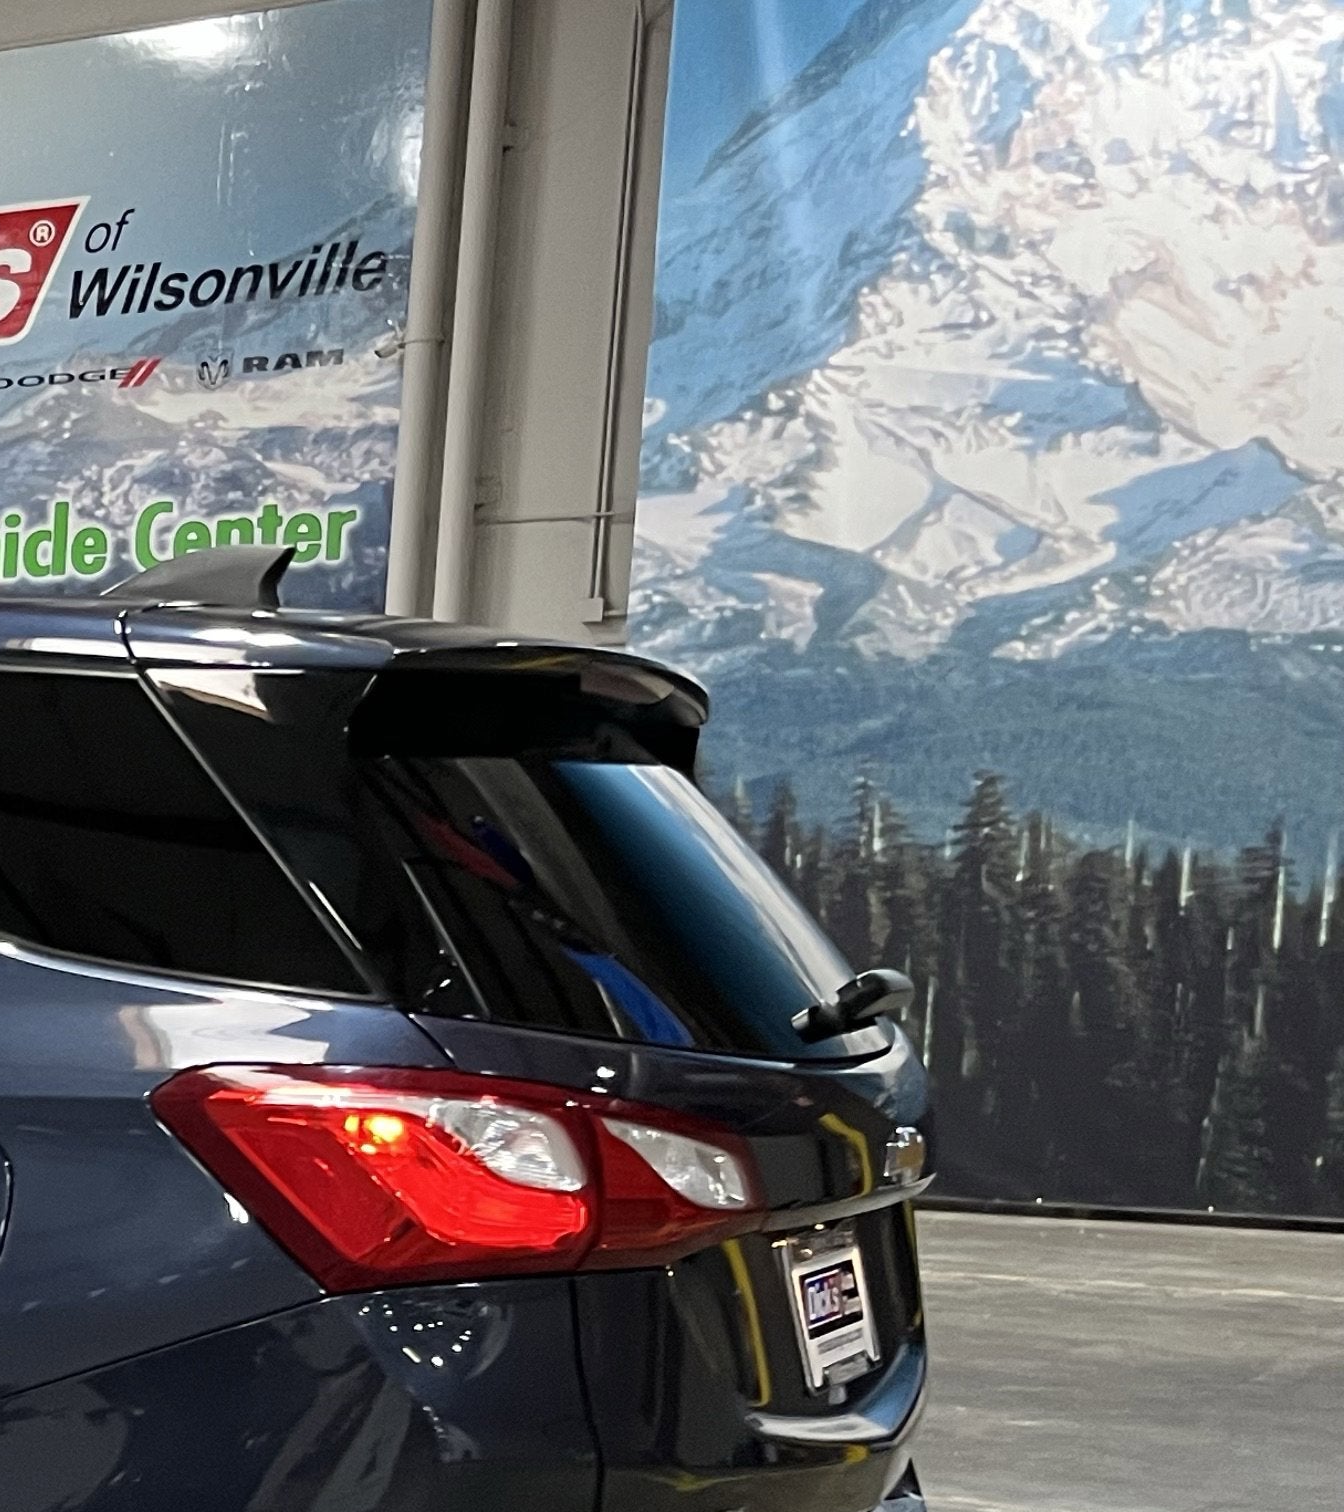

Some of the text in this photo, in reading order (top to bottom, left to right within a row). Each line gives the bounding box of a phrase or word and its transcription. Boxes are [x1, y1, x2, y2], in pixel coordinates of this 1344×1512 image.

[84, 208, 135, 254] of
[68, 239, 387, 320] Wilsonville
[242, 349, 344, 374] RAM
[135, 500, 357, 571] Center
